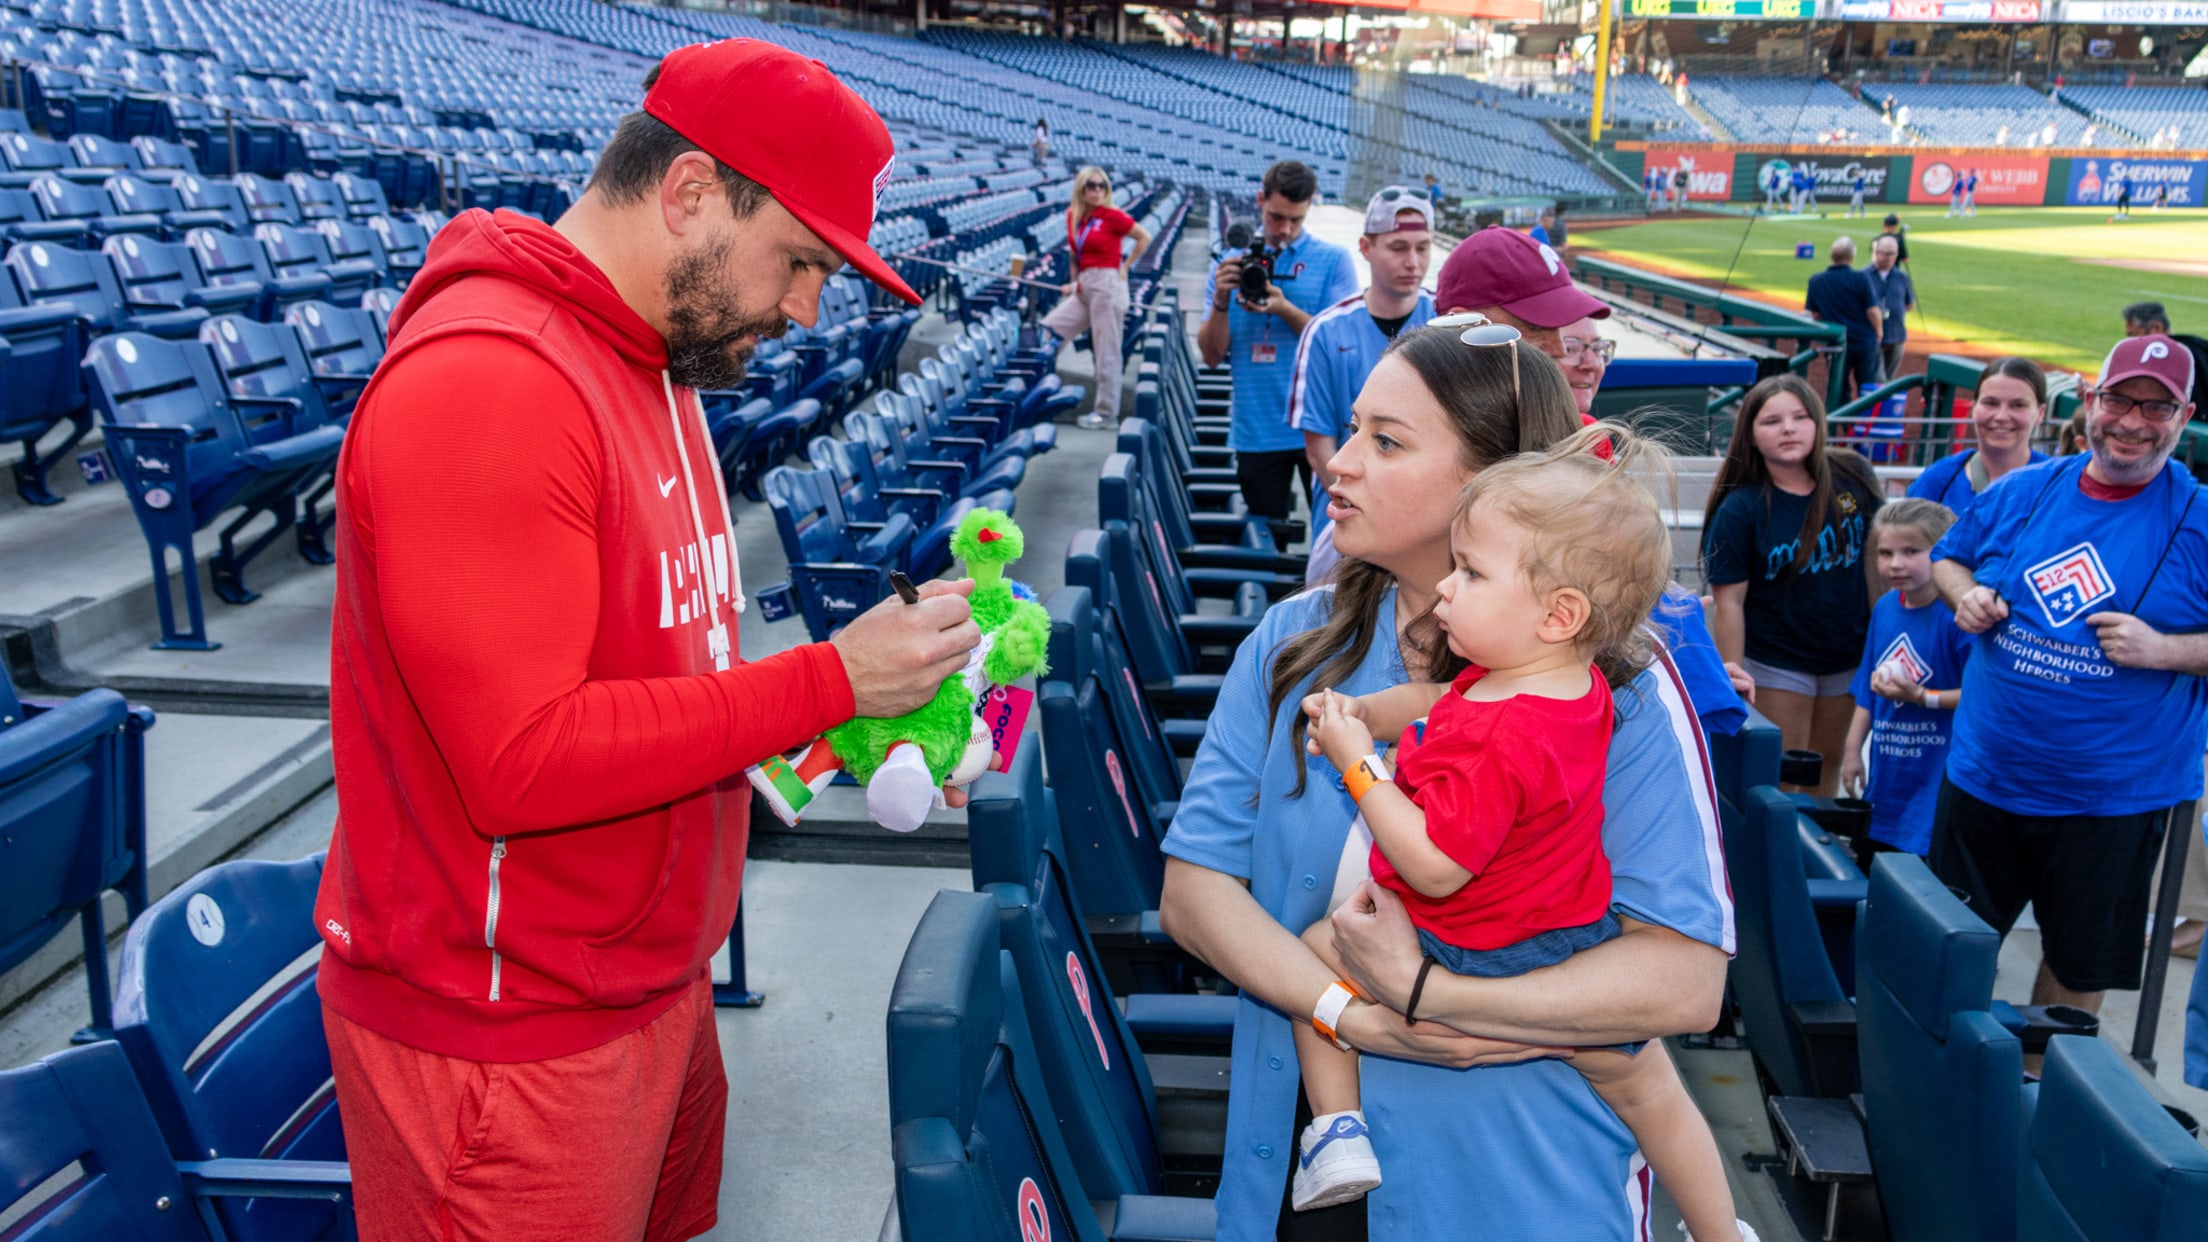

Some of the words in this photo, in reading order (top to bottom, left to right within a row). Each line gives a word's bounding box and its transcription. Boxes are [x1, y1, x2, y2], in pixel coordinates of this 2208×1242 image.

[2140, 341, 2169, 363] P
[2046, 568, 2067, 587] 12
[2007, 623, 2101, 660] SCHWARBER'S
[1994, 633, 2114, 677] NEIGHBORHOOD
[2013, 659, 2071, 685] HEROES
[1879, 744, 1922, 758] HEROES
